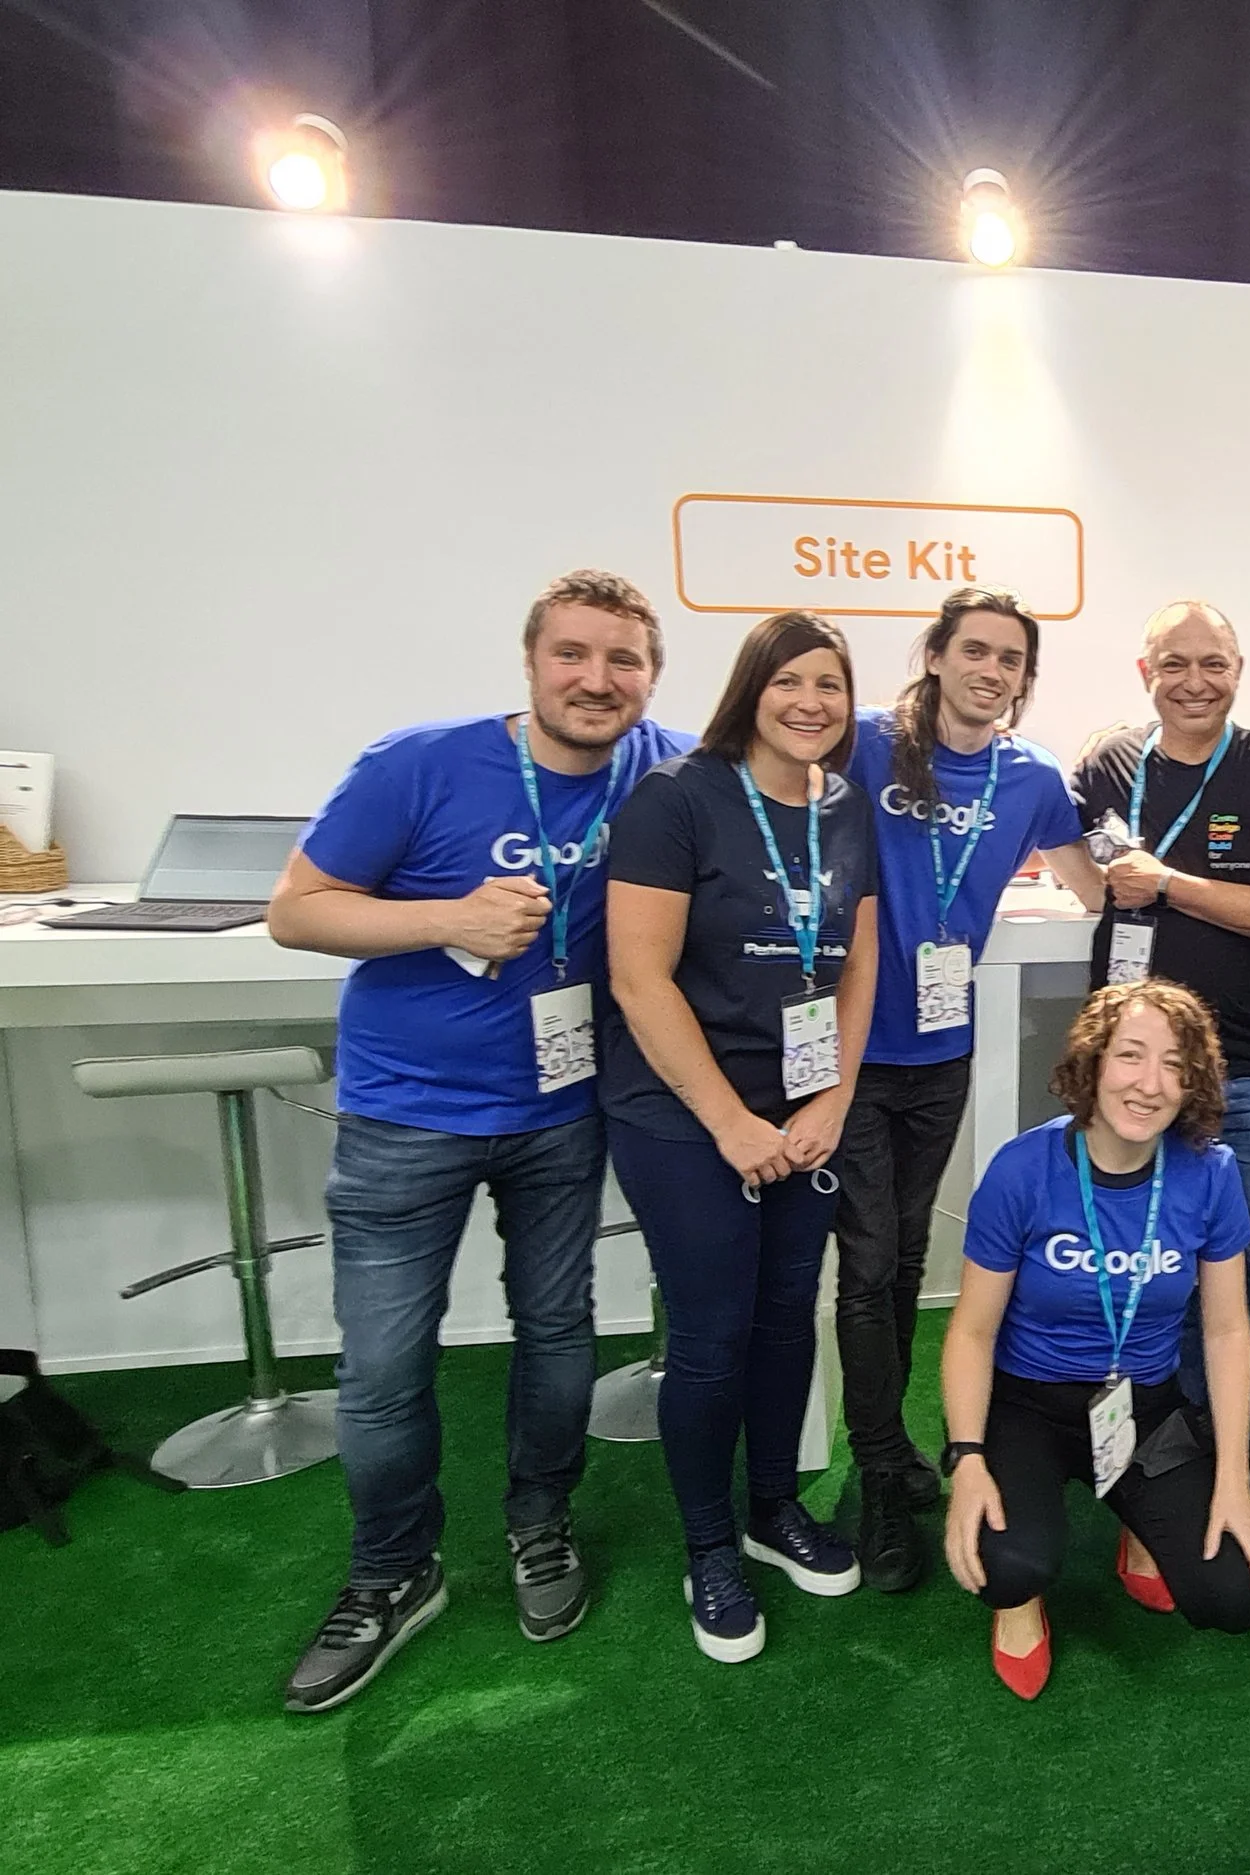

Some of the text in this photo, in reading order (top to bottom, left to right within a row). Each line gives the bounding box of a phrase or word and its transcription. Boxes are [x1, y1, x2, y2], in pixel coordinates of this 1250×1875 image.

[793, 536, 977, 582] Site Kit
[1045, 1233, 1183, 1284] Google
